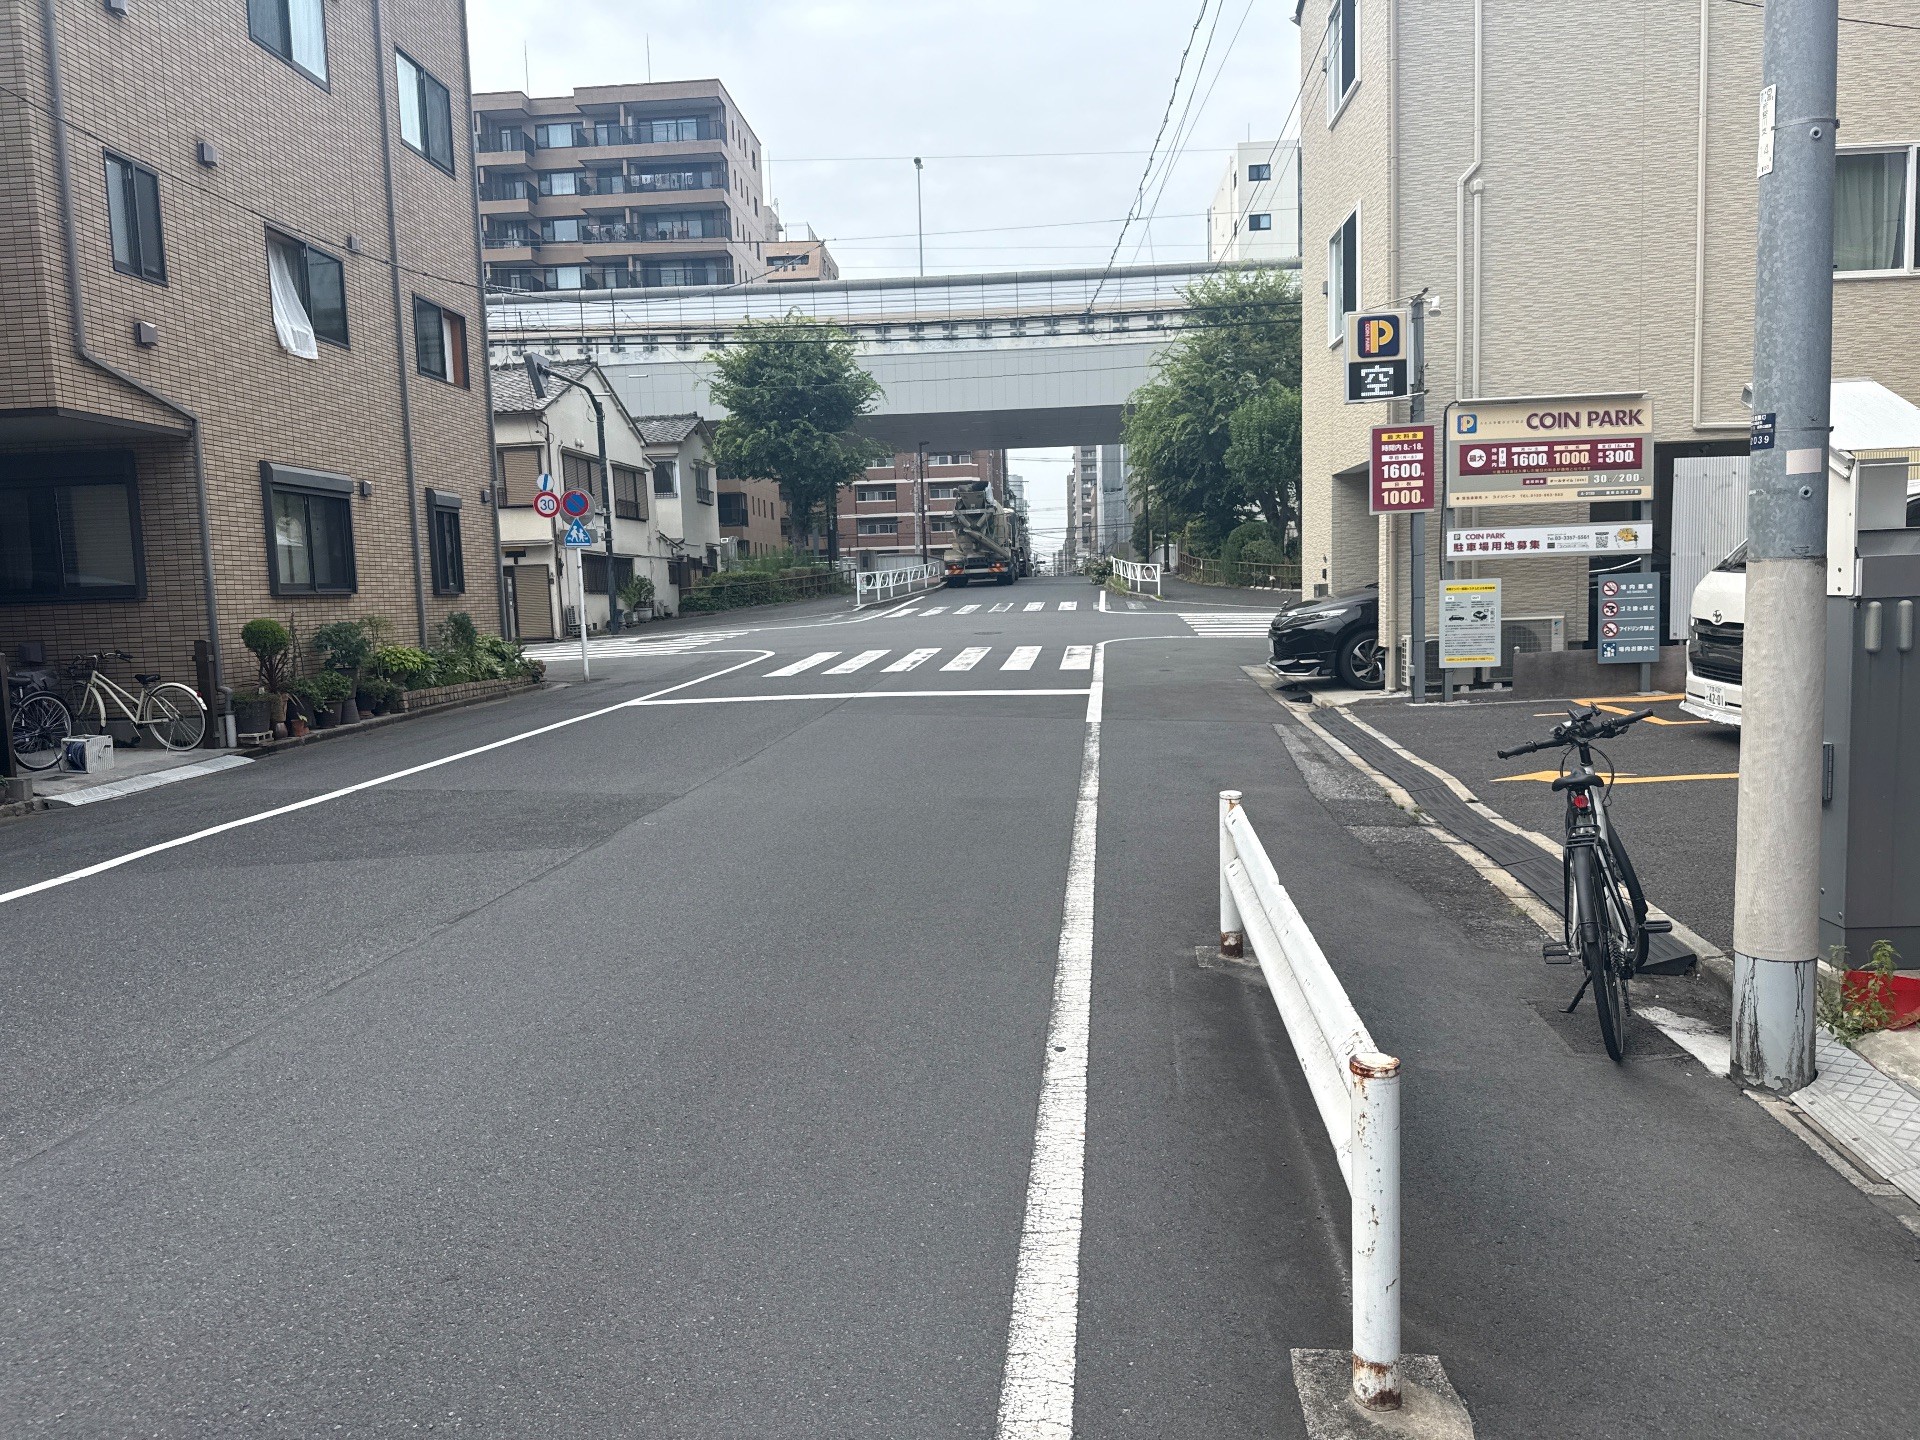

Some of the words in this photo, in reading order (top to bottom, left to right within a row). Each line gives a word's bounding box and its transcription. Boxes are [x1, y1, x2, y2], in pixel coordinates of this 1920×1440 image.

[1361, 365, 1394, 397] 空
[1526, 411, 1581, 430] COIN
[1587, 409, 1644, 427] PARK
[1387, 432, 1418, 440] 最大料金
[1469, 454, 1485, 463] 最大
[540, 499, 555, 511] 30
[1453, 540, 1540, 552] 駐車場用地募集
